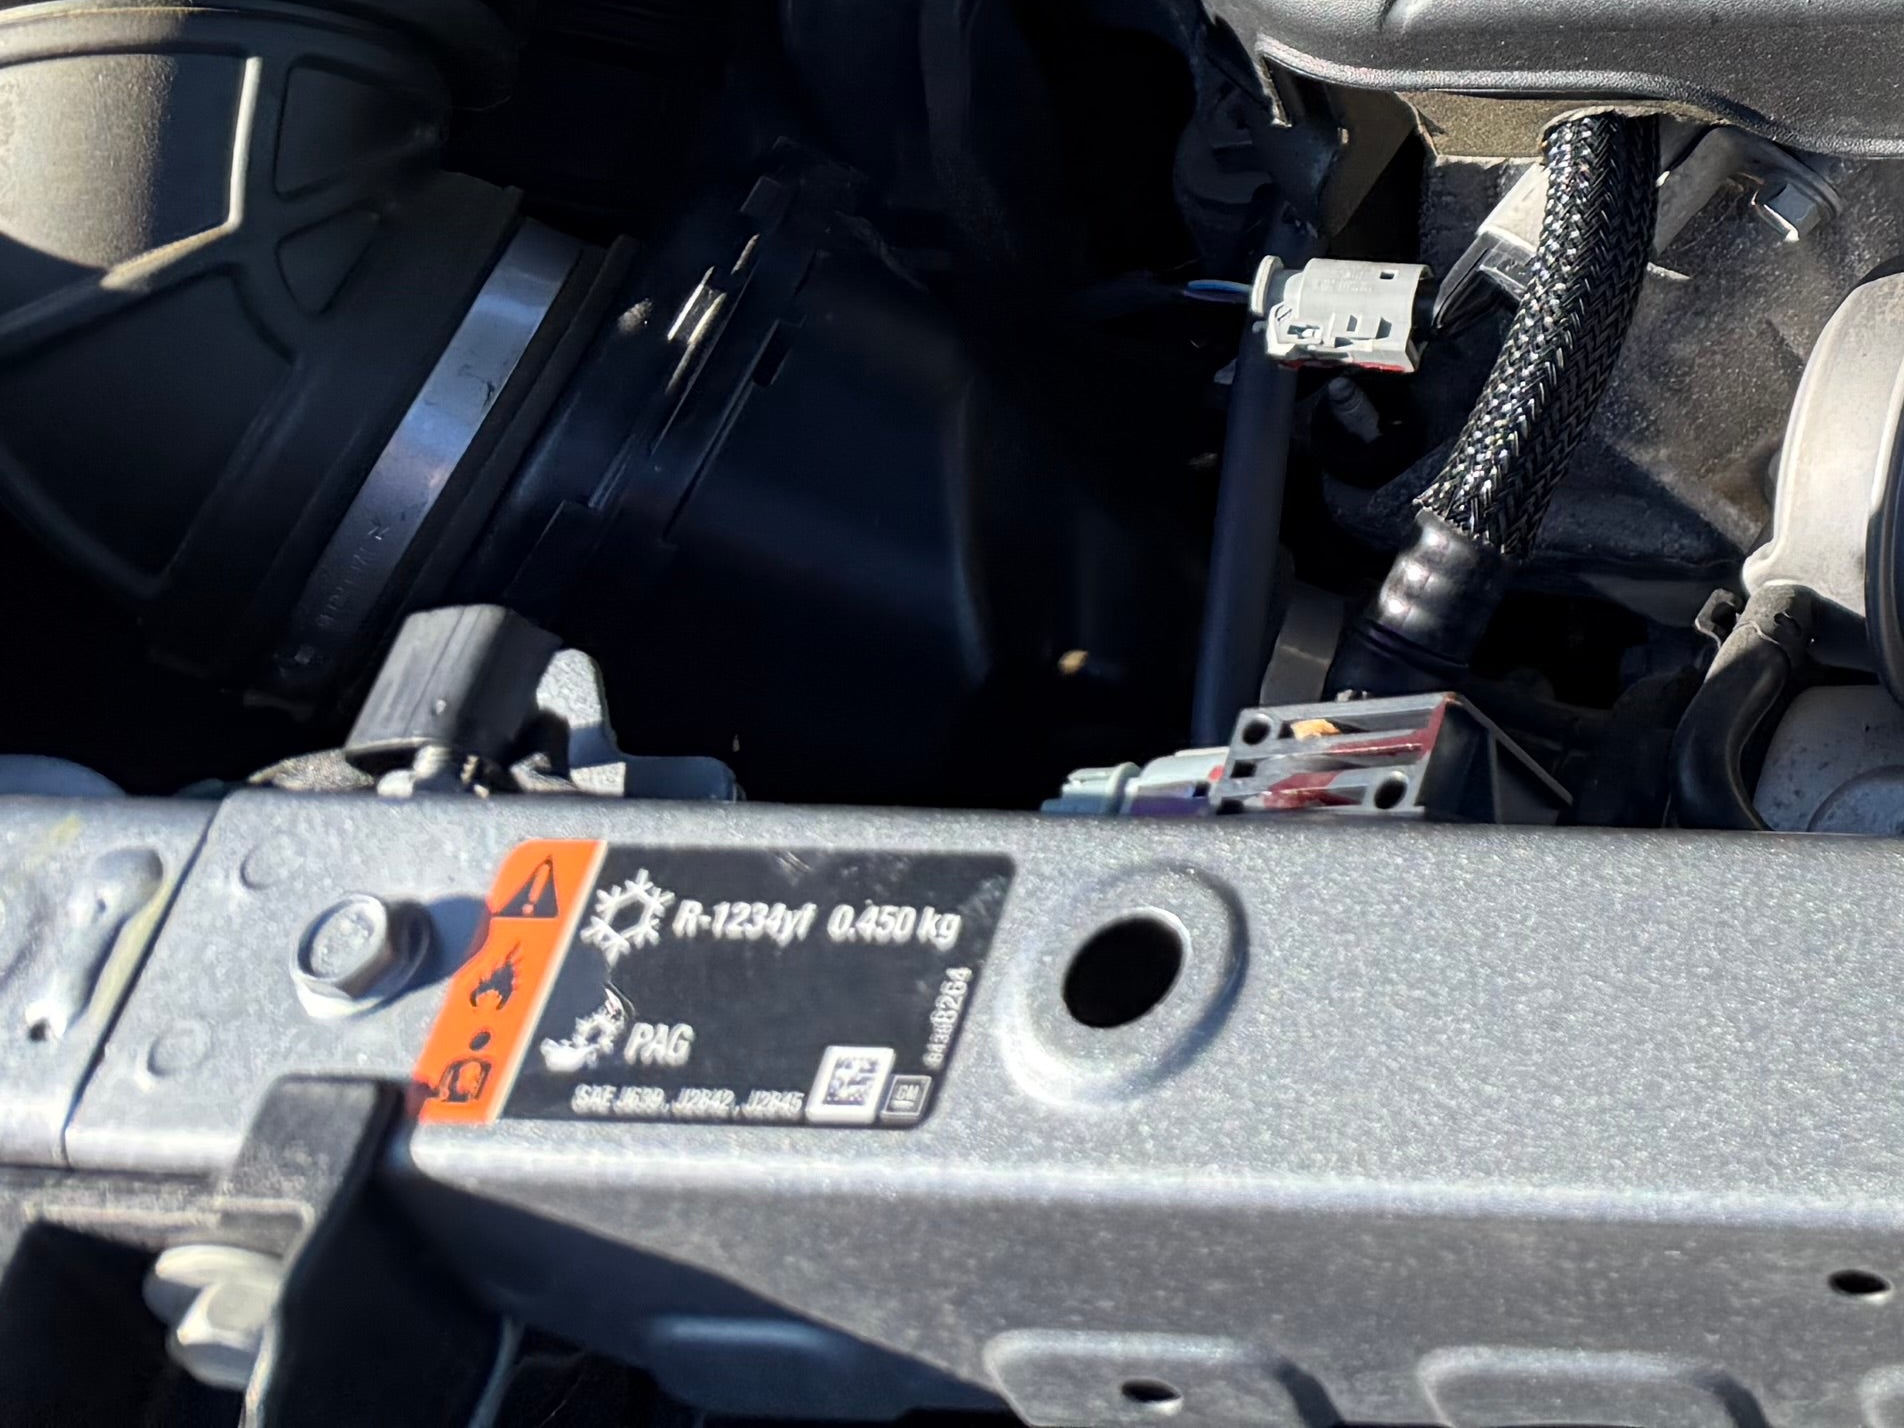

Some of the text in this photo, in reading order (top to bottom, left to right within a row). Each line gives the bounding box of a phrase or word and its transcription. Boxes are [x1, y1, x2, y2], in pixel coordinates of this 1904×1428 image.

[672, 899, 962, 952] R-1234yf 0.450 kg
[623, 1022, 696, 1067] PAG
[571, 1083, 617, 1116] SAE
